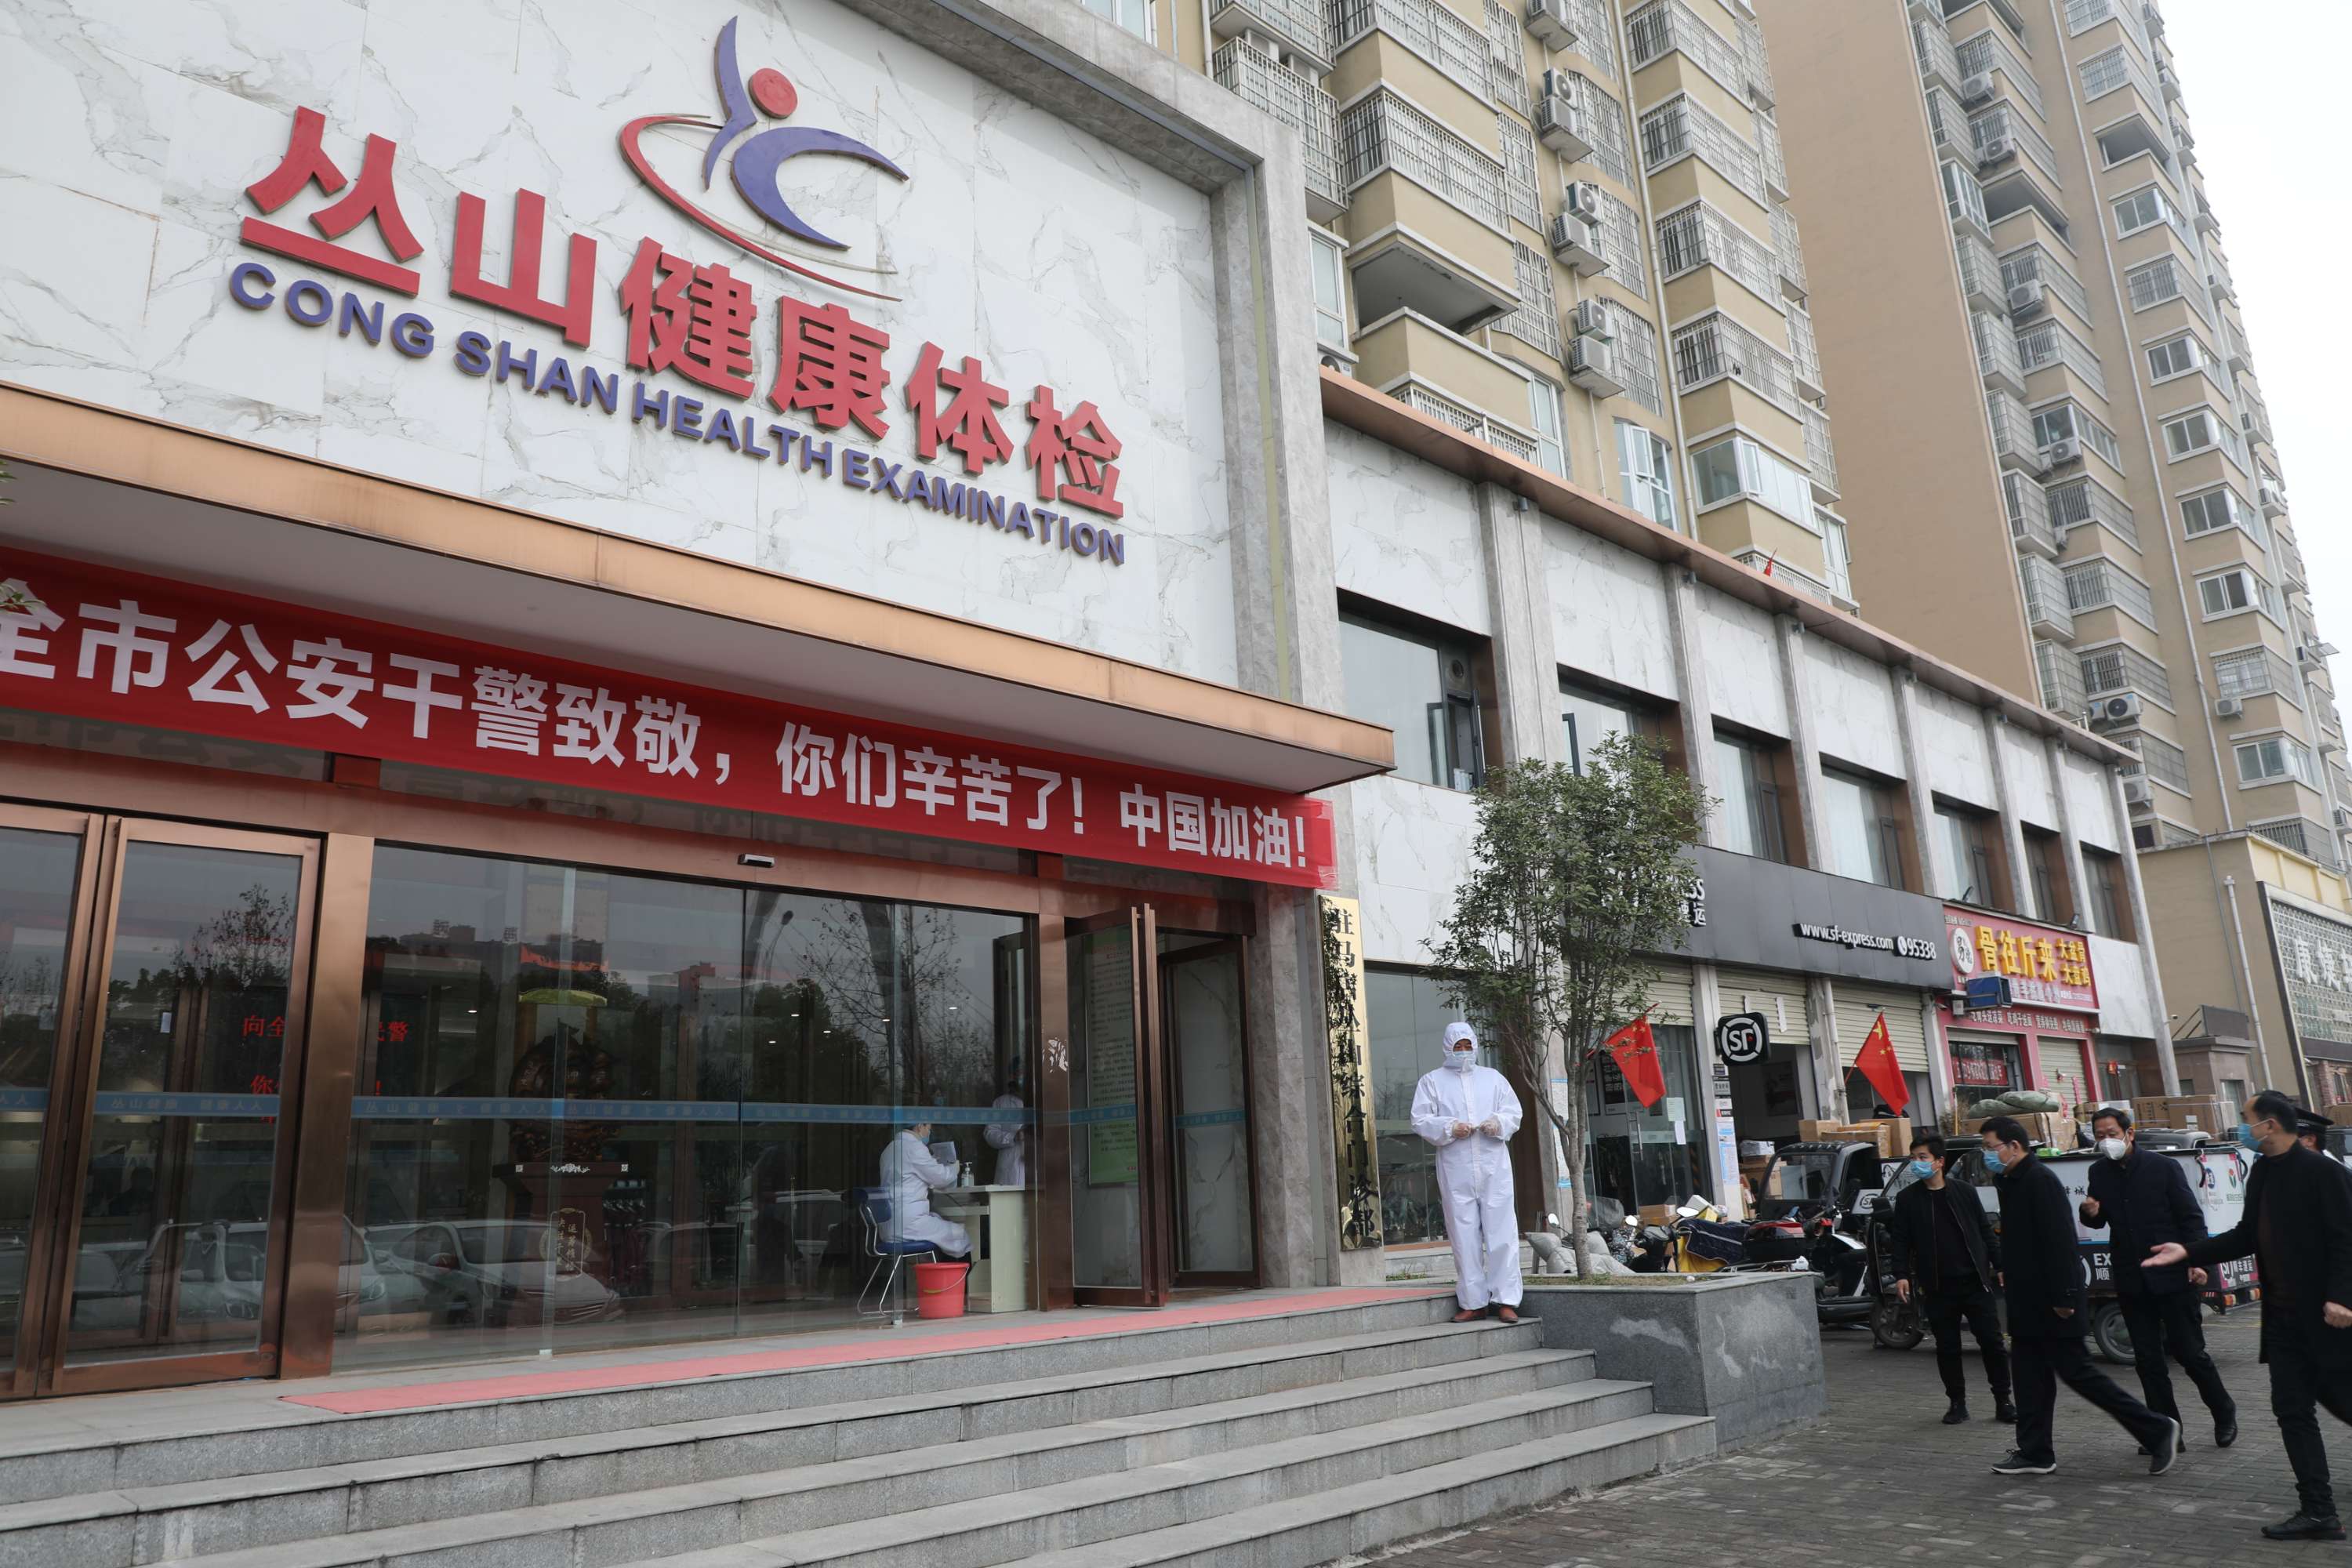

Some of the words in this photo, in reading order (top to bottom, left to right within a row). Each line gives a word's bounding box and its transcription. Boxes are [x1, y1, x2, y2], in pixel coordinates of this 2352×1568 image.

[229, 262, 435, 358] CONG
[453, 330, 619, 415] SHAN
[632, 382, 833, 478] HEALTH
[843, 448, 1125, 565] EXAMINATION
[240, 105, 1124, 519] 丛山健康体检
[1800, 923, 1894, 951] www.sf-express.com
[1907, 937, 1937, 960] 95338
